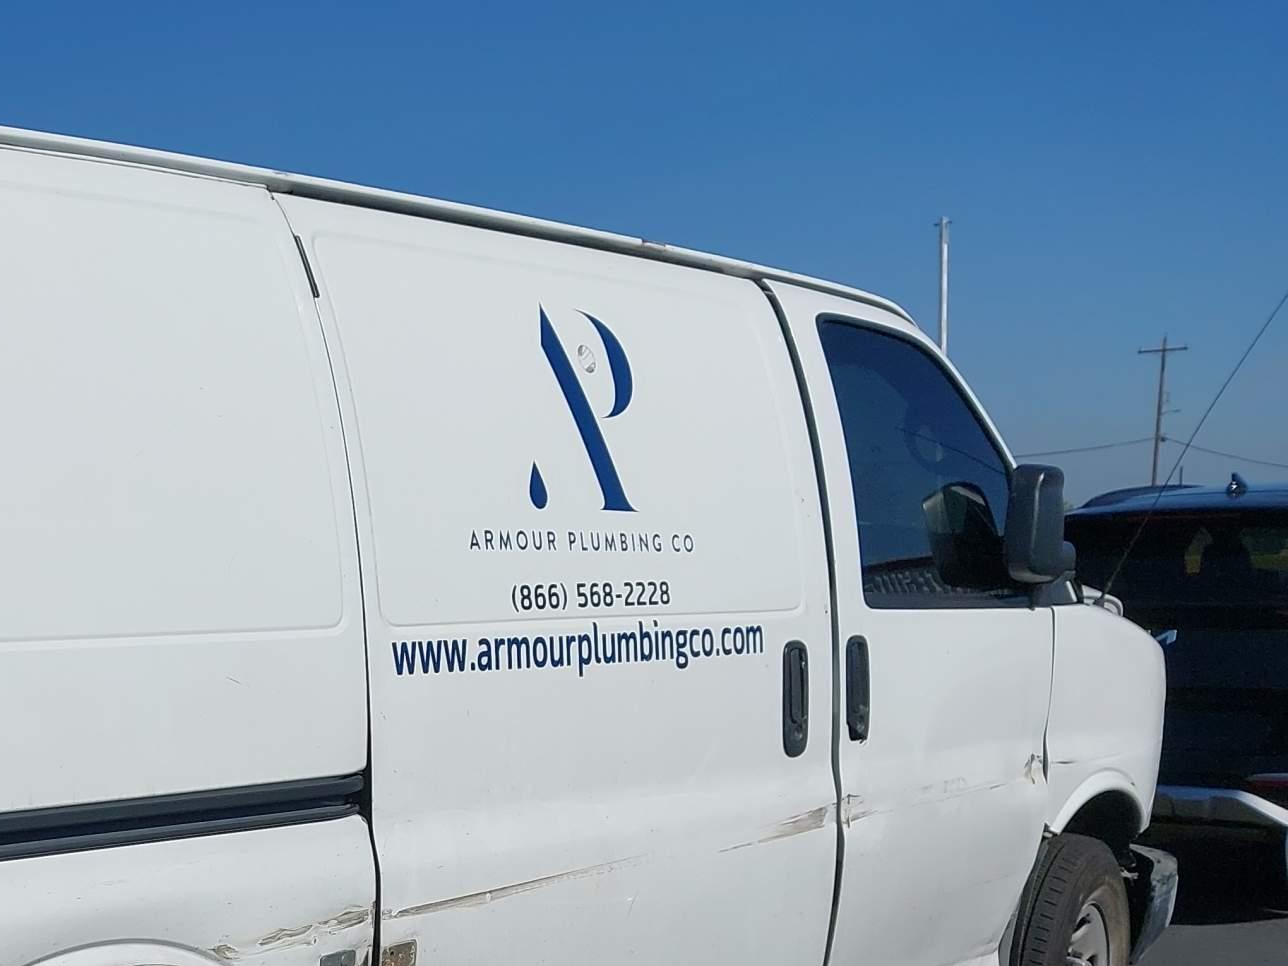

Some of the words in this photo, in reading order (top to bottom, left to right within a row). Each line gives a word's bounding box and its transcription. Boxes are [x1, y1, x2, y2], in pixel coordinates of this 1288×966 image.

[469, 529, 557, 551] ARMOUR
[567, 531, 662, 553] PLUMBING
[671, 534, 694, 553] CO
[511, 582, 568, 612] (866)
[576, 581, 671, 608] 568-2228
[391, 620, 764, 677] www.armourplumbingco.com
